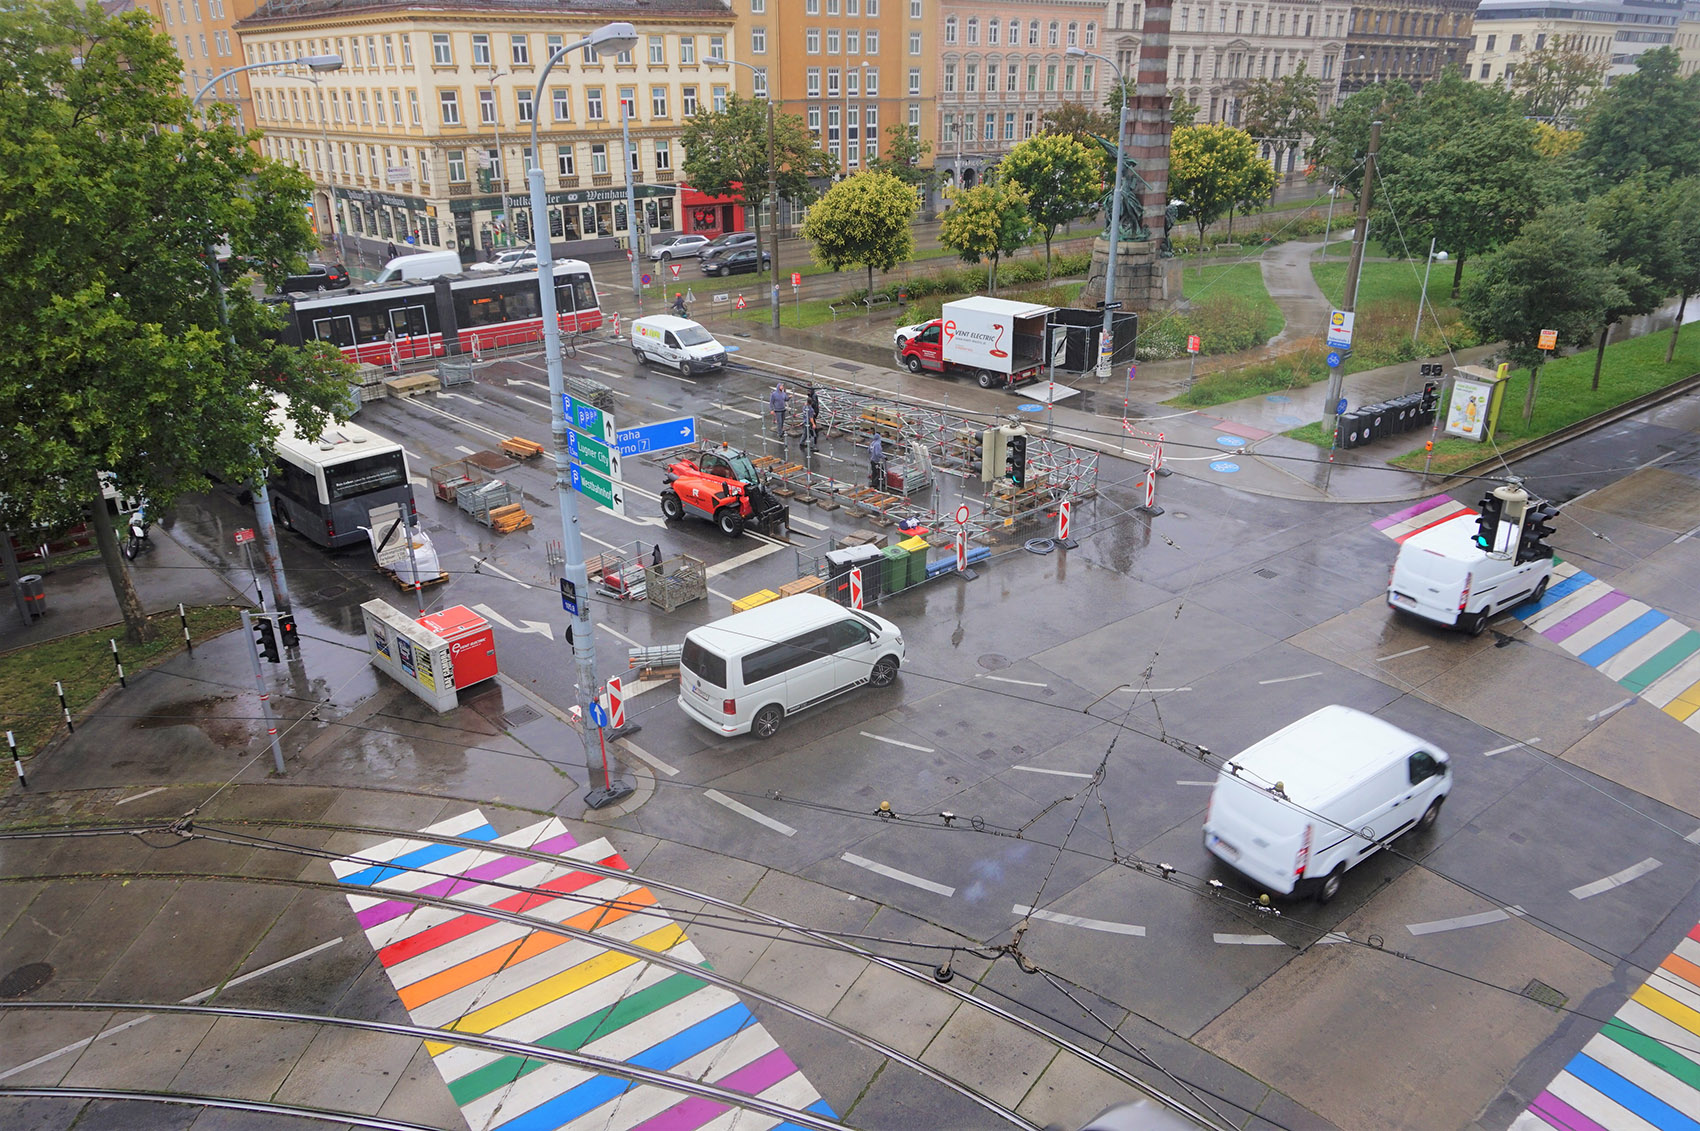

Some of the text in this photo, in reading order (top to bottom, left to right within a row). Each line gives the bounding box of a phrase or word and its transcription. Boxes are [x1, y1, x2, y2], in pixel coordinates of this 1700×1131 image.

[586, 190, 629, 200] Weinhaus
[970, 332, 995, 342] ELECTRIC
[578, 441, 609, 467] Lugner City
[580, 475, 612, 500] Westbahnhof
